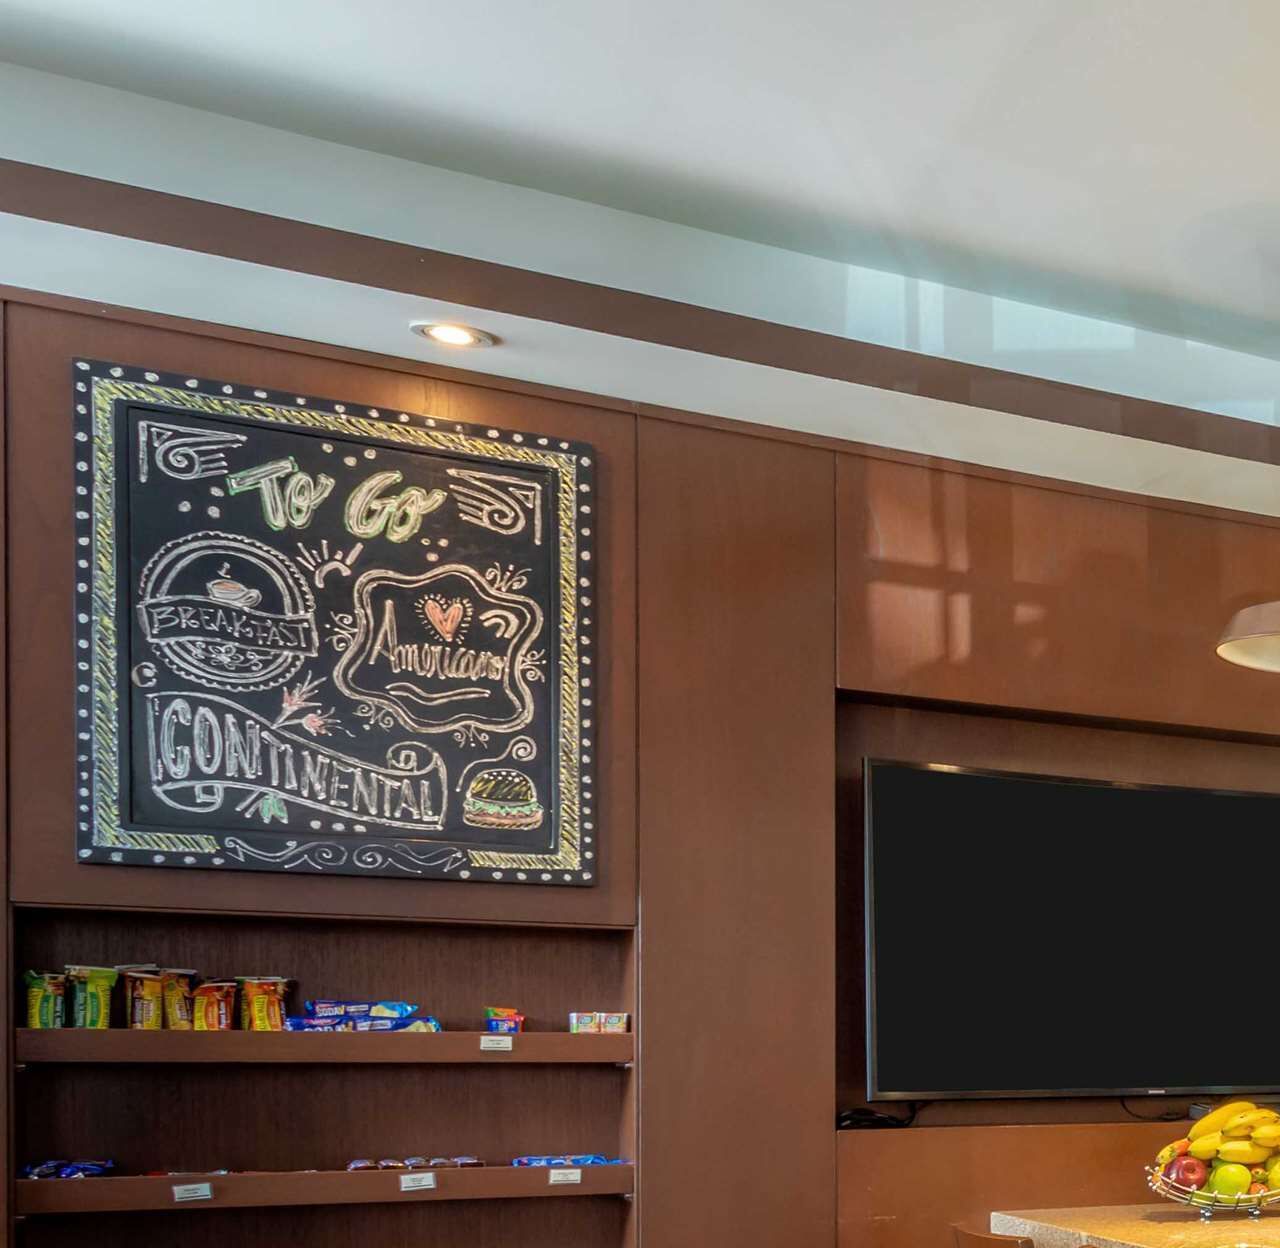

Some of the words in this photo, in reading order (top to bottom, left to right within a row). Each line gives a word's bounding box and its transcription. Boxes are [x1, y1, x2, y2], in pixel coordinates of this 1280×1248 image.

[226, 457, 335, 531] To
[344, 469, 446, 543] Go
[151, 603, 311, 650] BREAKFAST
[159, 698, 443, 821] CONTINENTAL
